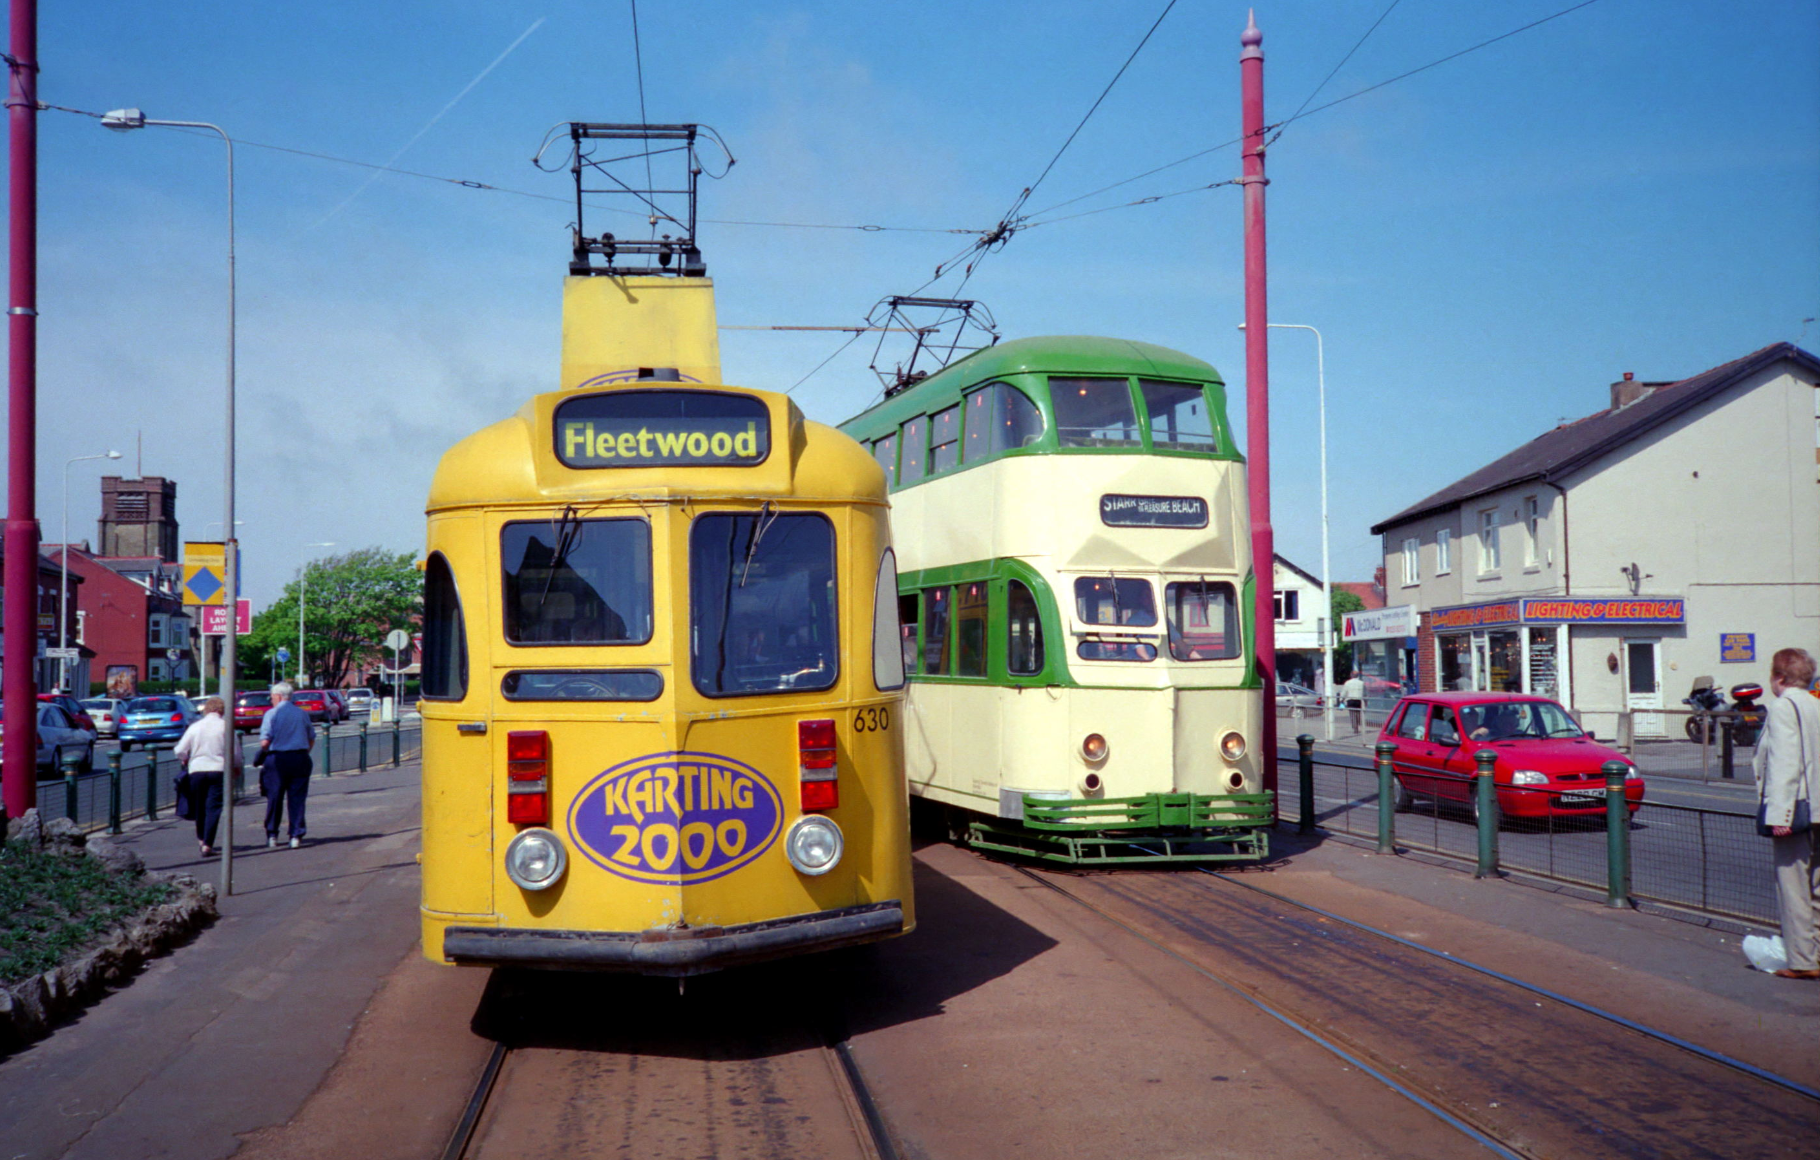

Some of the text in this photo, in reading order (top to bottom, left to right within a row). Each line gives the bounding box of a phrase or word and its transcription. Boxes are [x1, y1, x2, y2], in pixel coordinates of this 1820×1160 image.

[565, 421, 758, 458] Fleetwood
[1172, 499, 1200, 513] BEACH
[1483, 603, 1519, 623] ELECTRICAL
[1525, 601, 1683, 619] LIGHTING & ELECTRICAL
[854, 706, 890, 733] 630
[604, 765, 754, 825] KARTING
[610, 818, 747, 871] 2000
